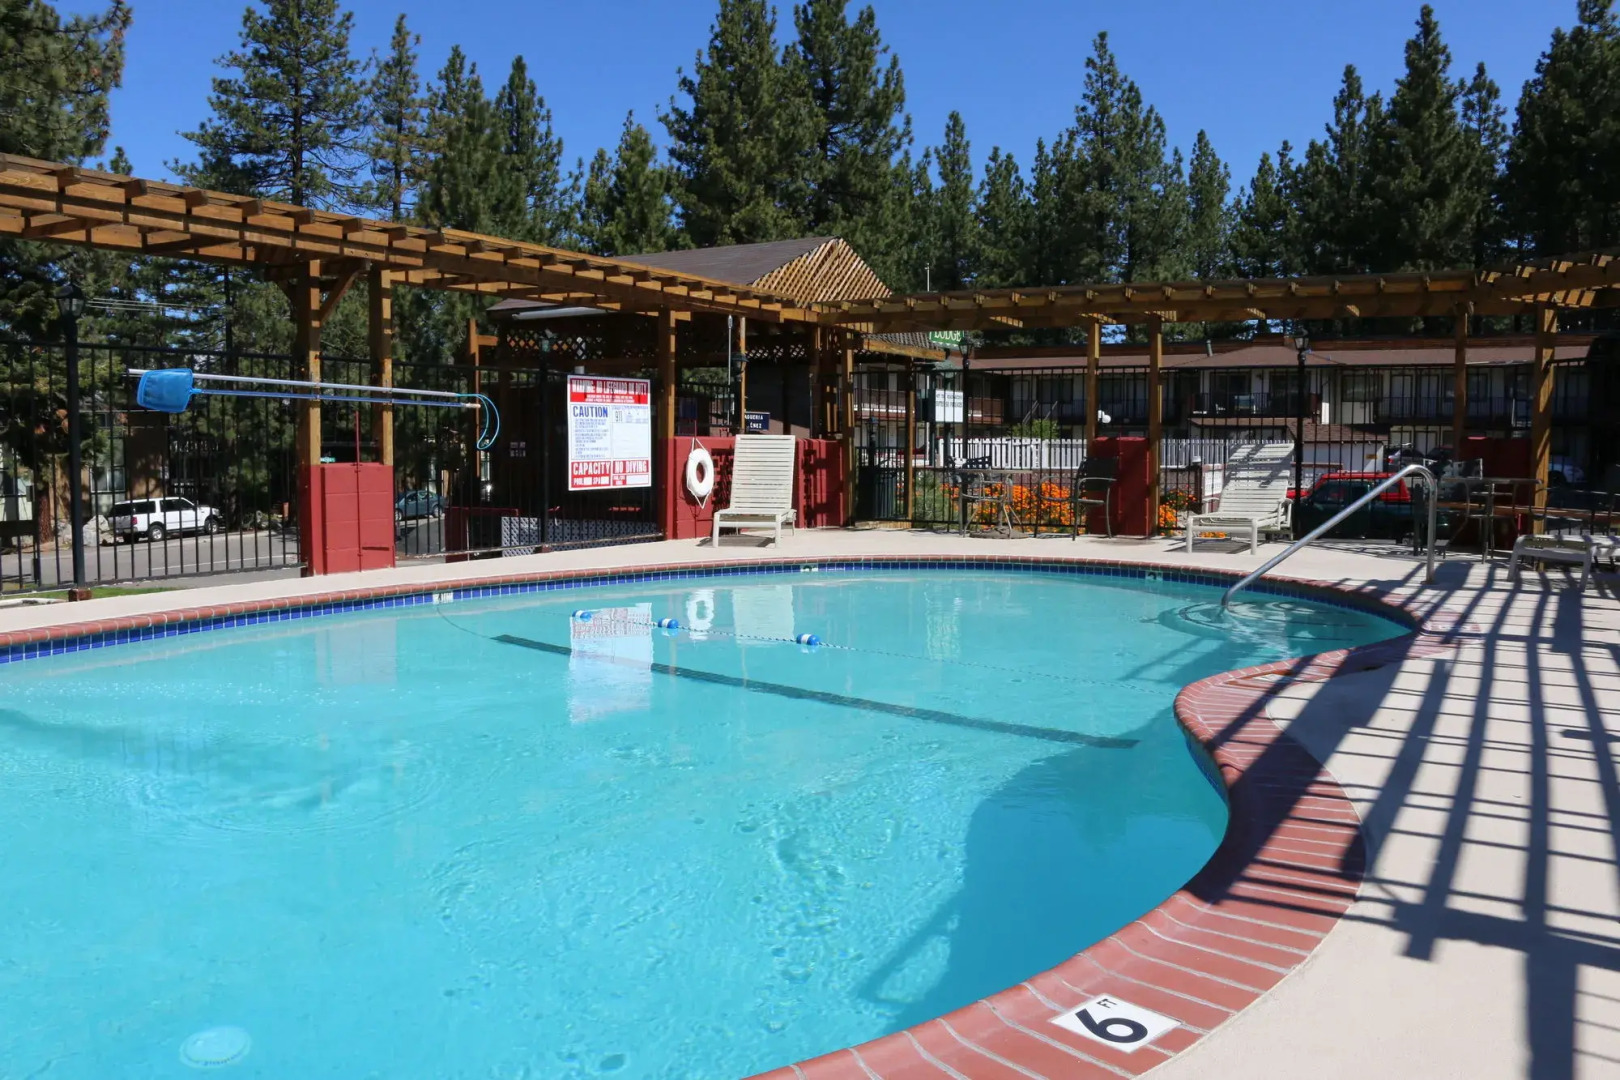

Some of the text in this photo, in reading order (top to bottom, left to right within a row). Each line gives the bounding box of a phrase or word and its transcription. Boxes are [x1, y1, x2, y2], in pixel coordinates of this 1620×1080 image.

[934, 330, 962, 342] LODGE
[603, 381, 628, 394] LIFEGUARD
[628, 382, 635, 394] ON
[635, 382, 647, 395] DUTY
[572, 405, 608, 418] CAUTION
[572, 461, 611, 476] CAPACITY
[614, 459, 647, 474] NO DIVING
[1075, 998, 1148, 1043] 6 FT
